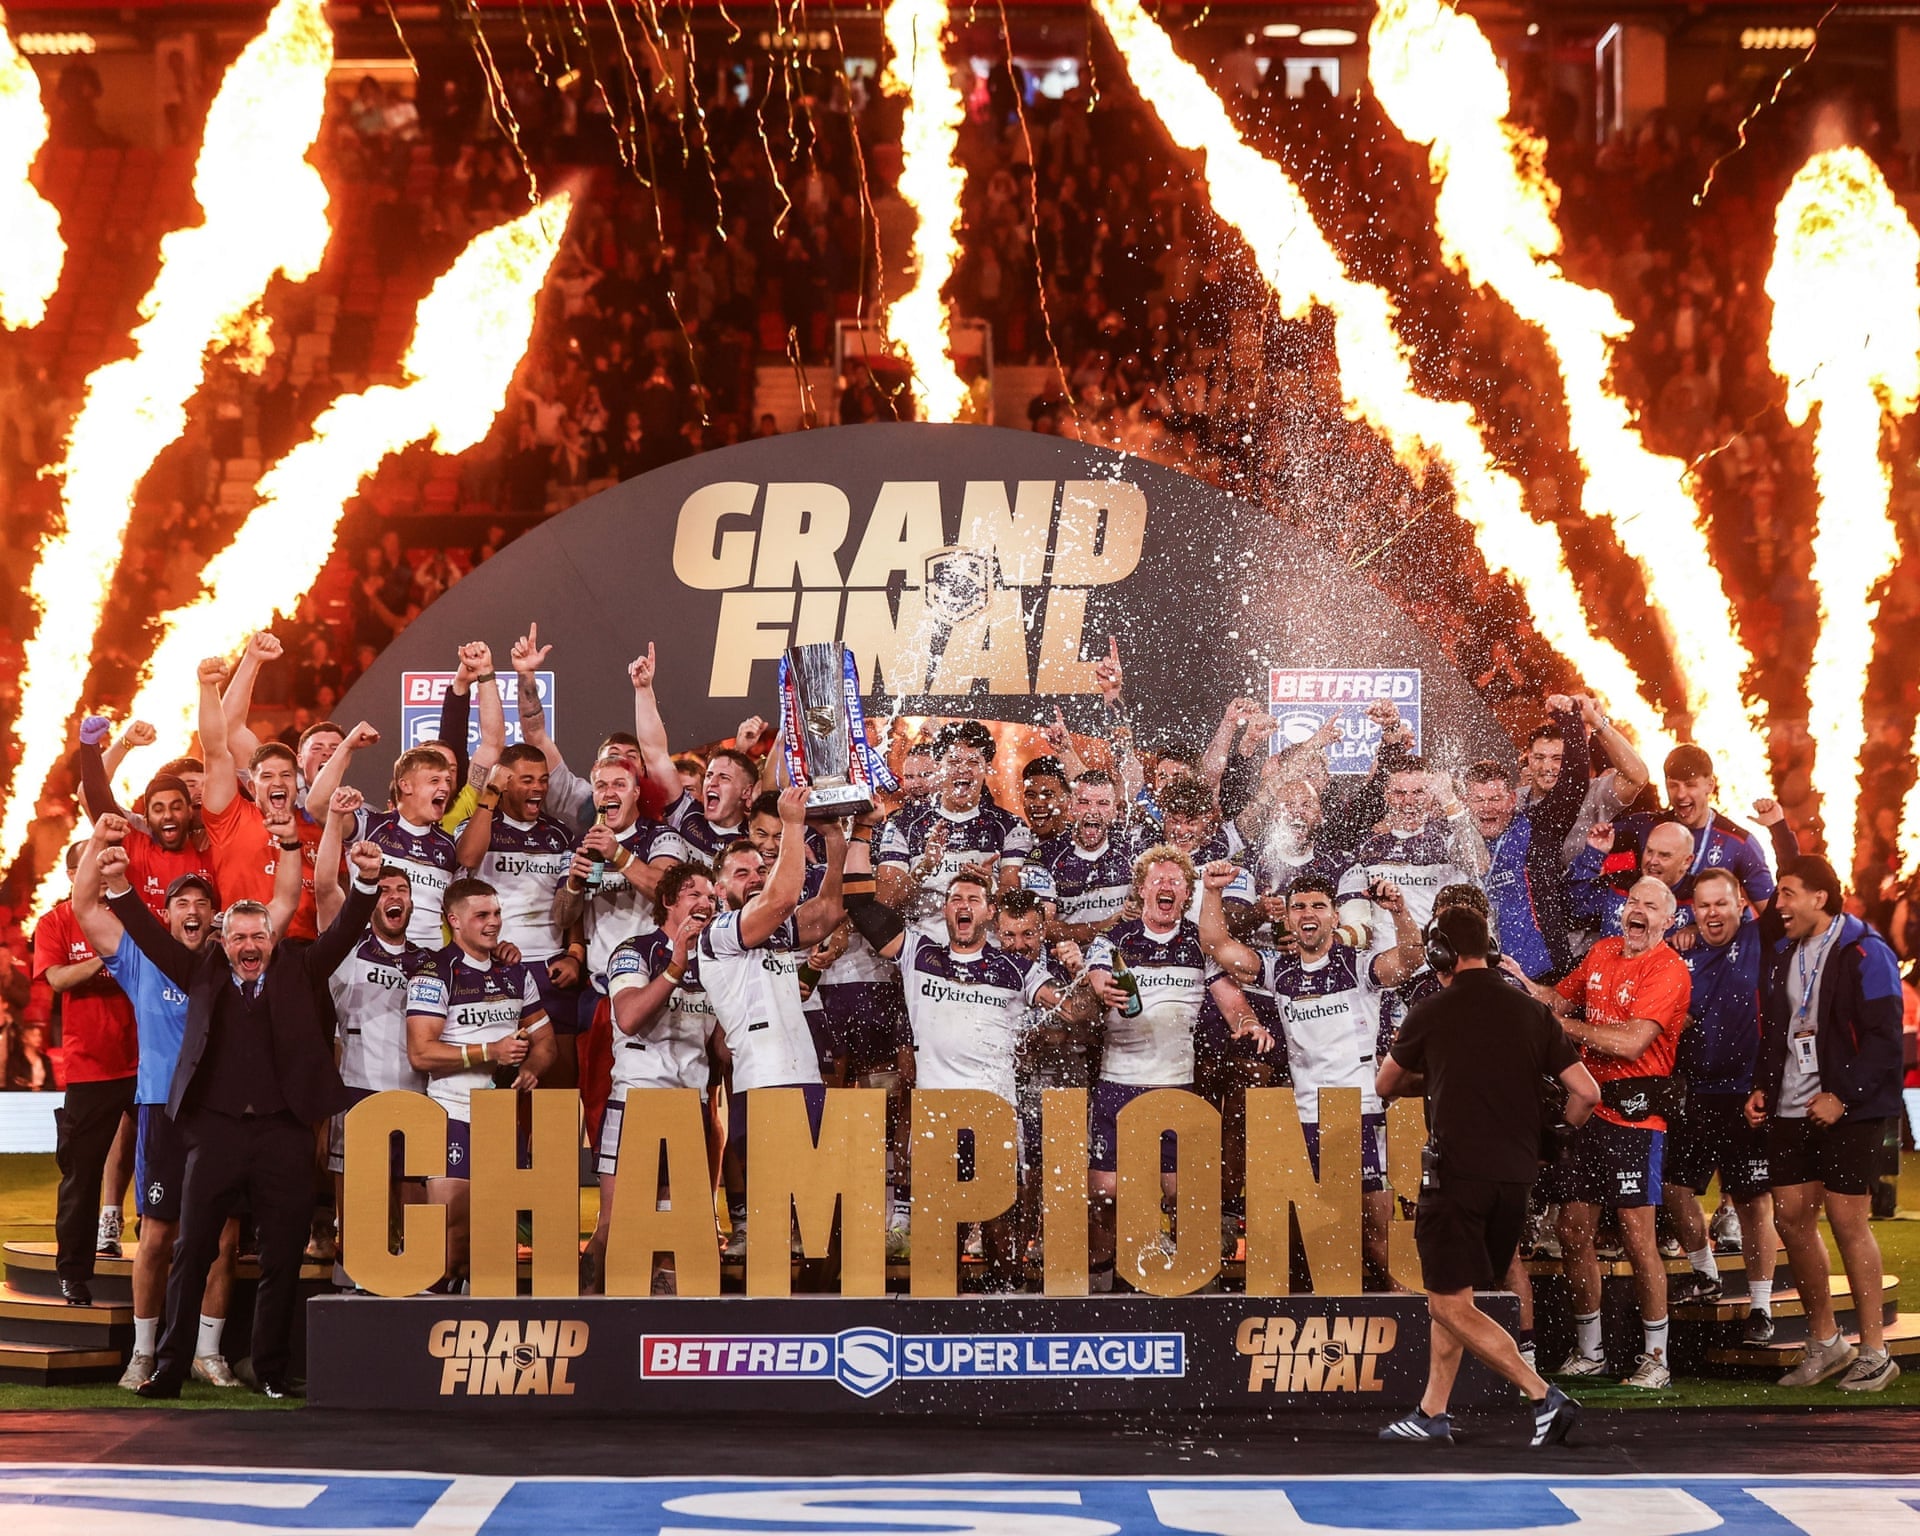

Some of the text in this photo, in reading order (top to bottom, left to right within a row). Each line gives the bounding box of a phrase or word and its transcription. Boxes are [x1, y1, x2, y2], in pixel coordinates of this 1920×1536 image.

[673, 480, 1147, 590] GRAND
[708, 590, 1106, 698] FINAL
[1277, 675, 1413, 698] BETFRED
[844, 678, 865, 738] BETFRED
[921, 978, 1007, 1009] diykitchens
[428, 1319, 590, 1359] GRAND
[1235, 1316, 1398, 1355] GRAND
[651, 1342, 829, 1372] BETFRED
[904, 1340, 1175, 1373] SUPER LEAGUE
[1247, 1354, 1384, 1392] FINAL
[439, 1357, 576, 1395] FINAL
